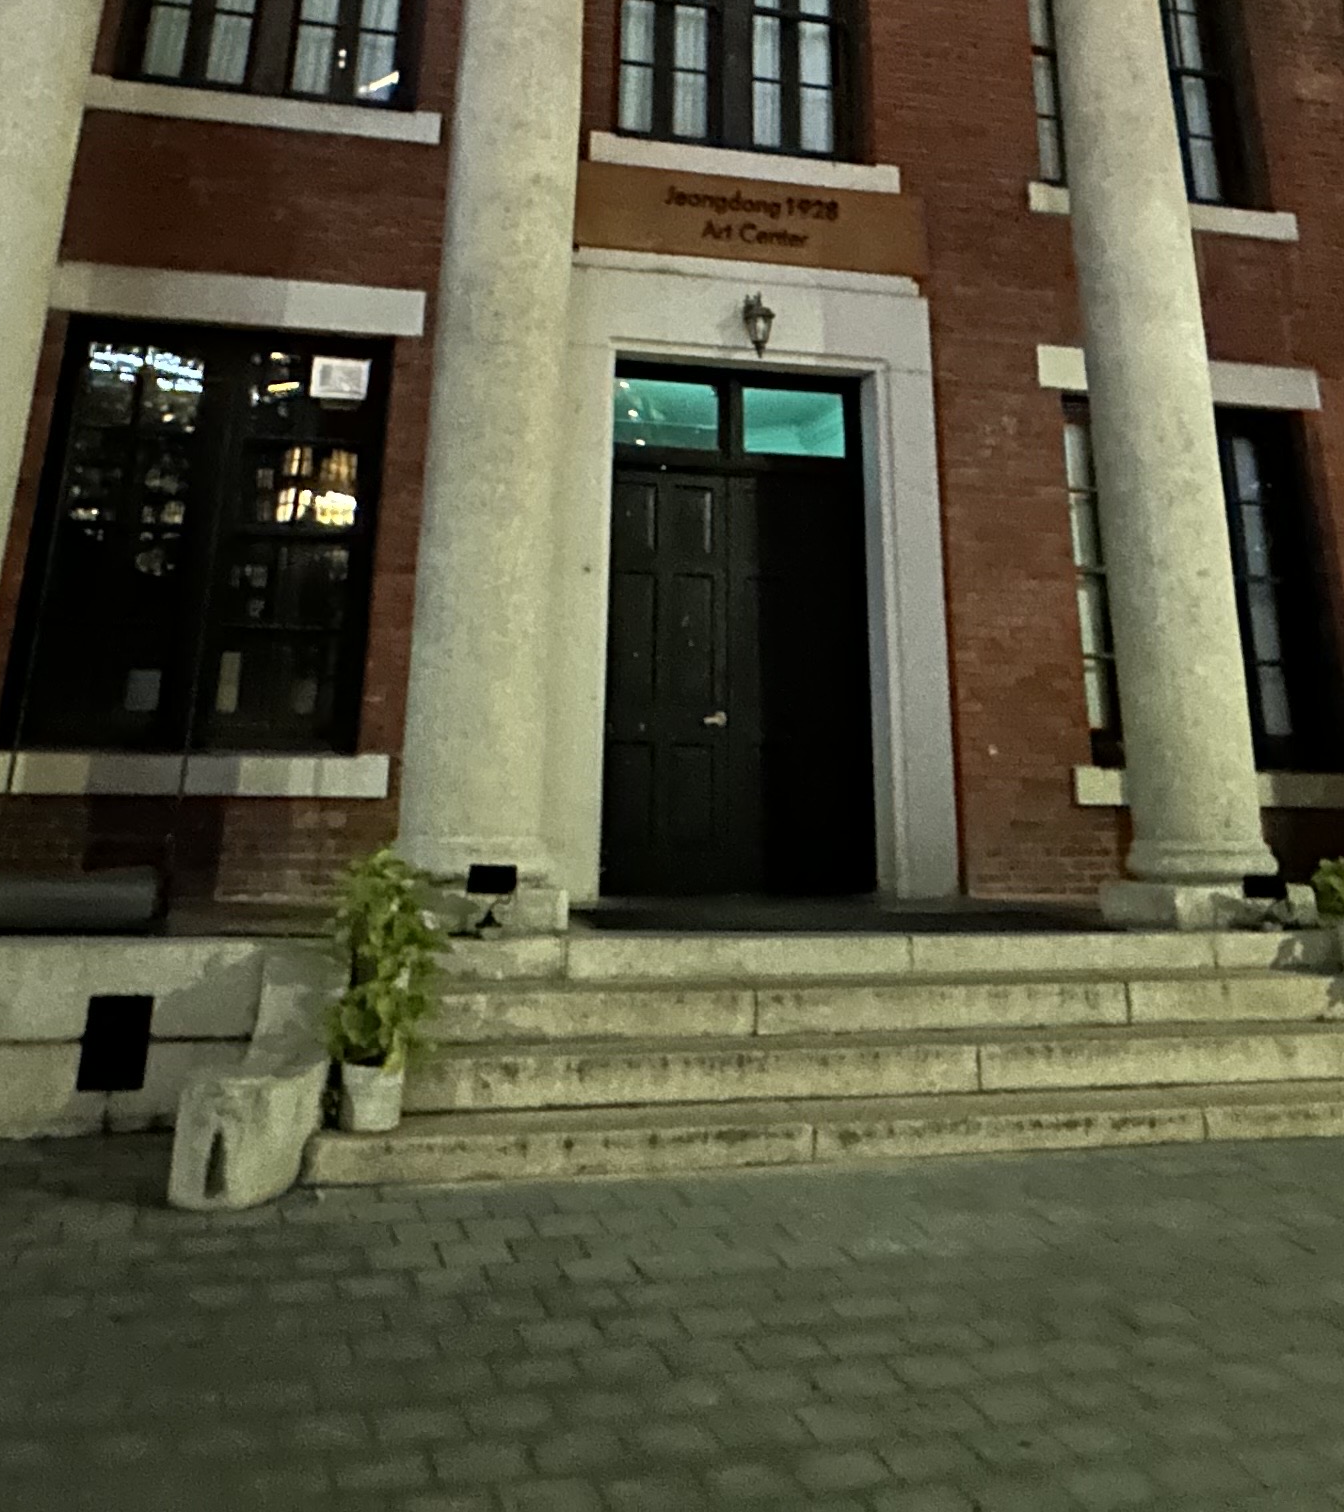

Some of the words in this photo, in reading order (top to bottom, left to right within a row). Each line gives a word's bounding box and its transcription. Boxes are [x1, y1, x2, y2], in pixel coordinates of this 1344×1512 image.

[664, 185, 782, 219] Jeongdong
[785, 195, 840, 222] 1928
[702, 219, 733, 241] Art
[738, 222, 810, 248] Center
